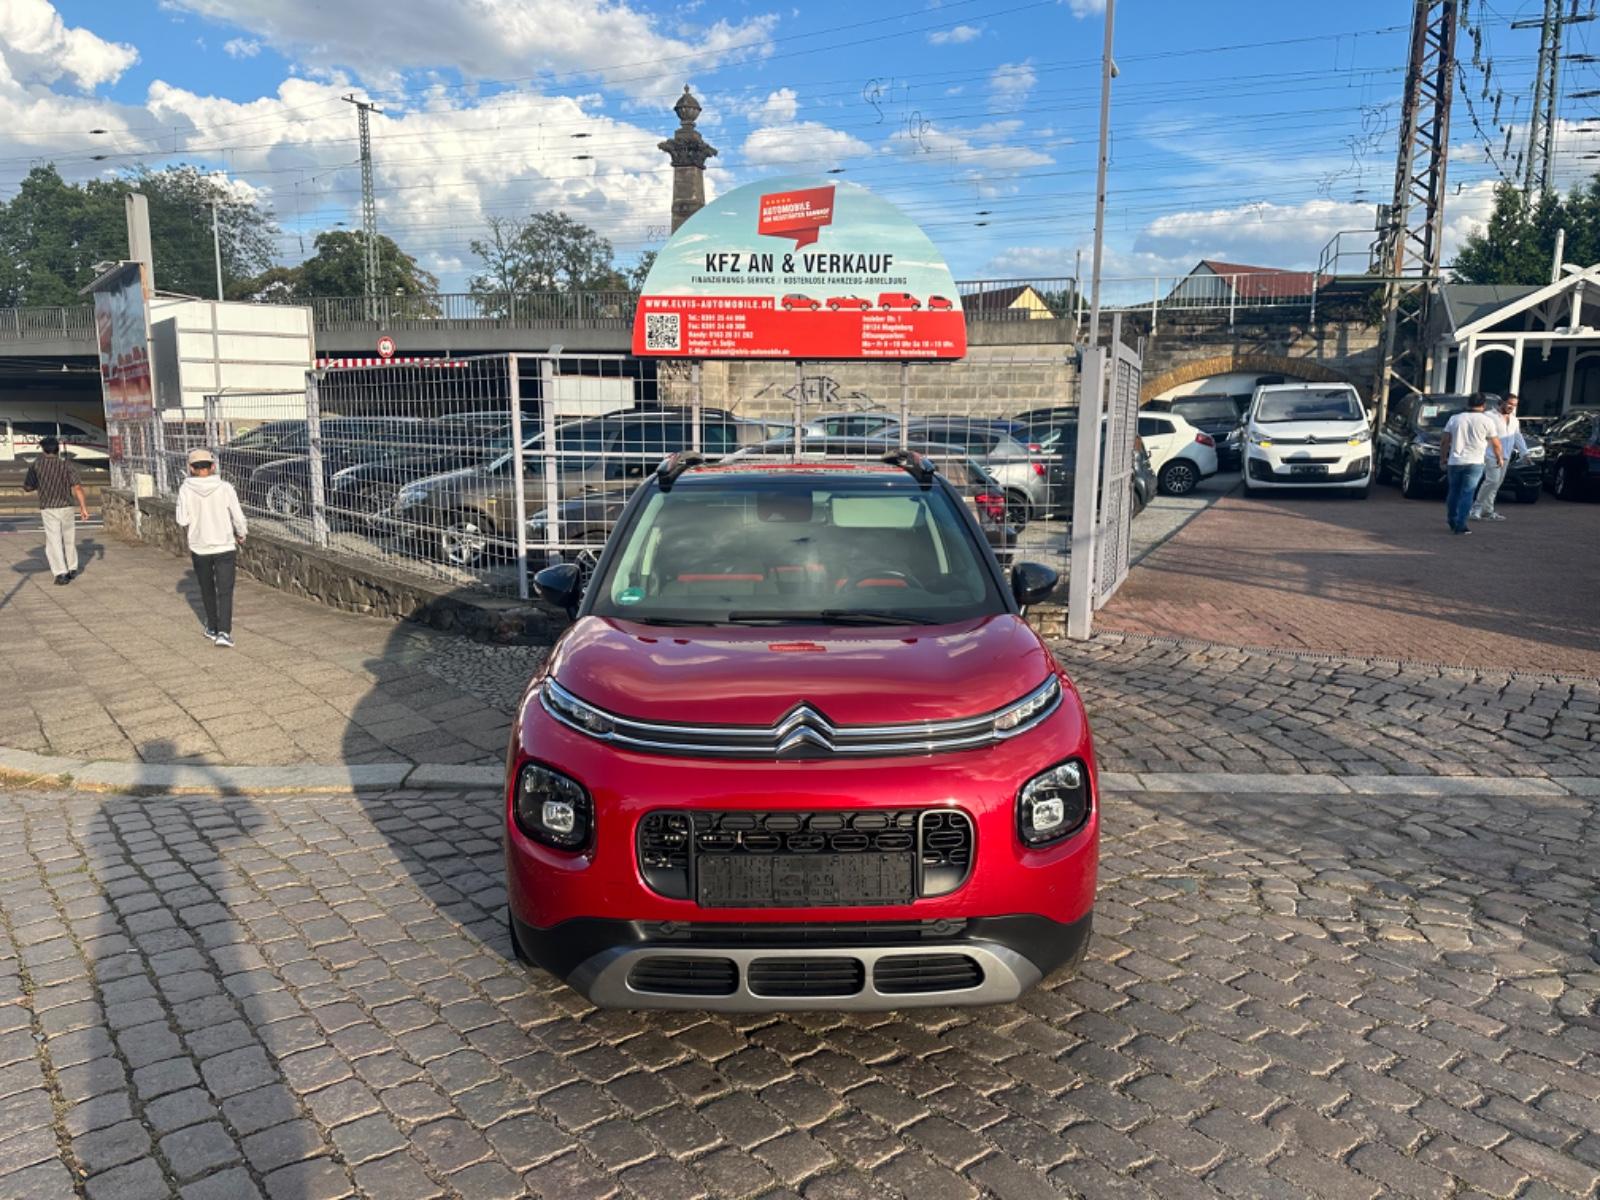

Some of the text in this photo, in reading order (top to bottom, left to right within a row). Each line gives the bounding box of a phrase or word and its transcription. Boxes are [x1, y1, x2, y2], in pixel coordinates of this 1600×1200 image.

[763, 201, 811, 216] AUTOMOBILE
[705, 253, 893, 273] KFZ AN & VERKAUF
[691, 276, 775, 284] FINANZIERUNGS-SERVICE
[784, 277, 826, 285] KOSTENLOSE
[828, 277, 907, 285] FAHRZEUG-ABMELDUNG
[645, 299, 774, 309] WWW.ELVIS-AUTOMOBILE.DE
[882, 323, 914, 332] Magdeburg
[688, 331, 708, 340] Handy:
